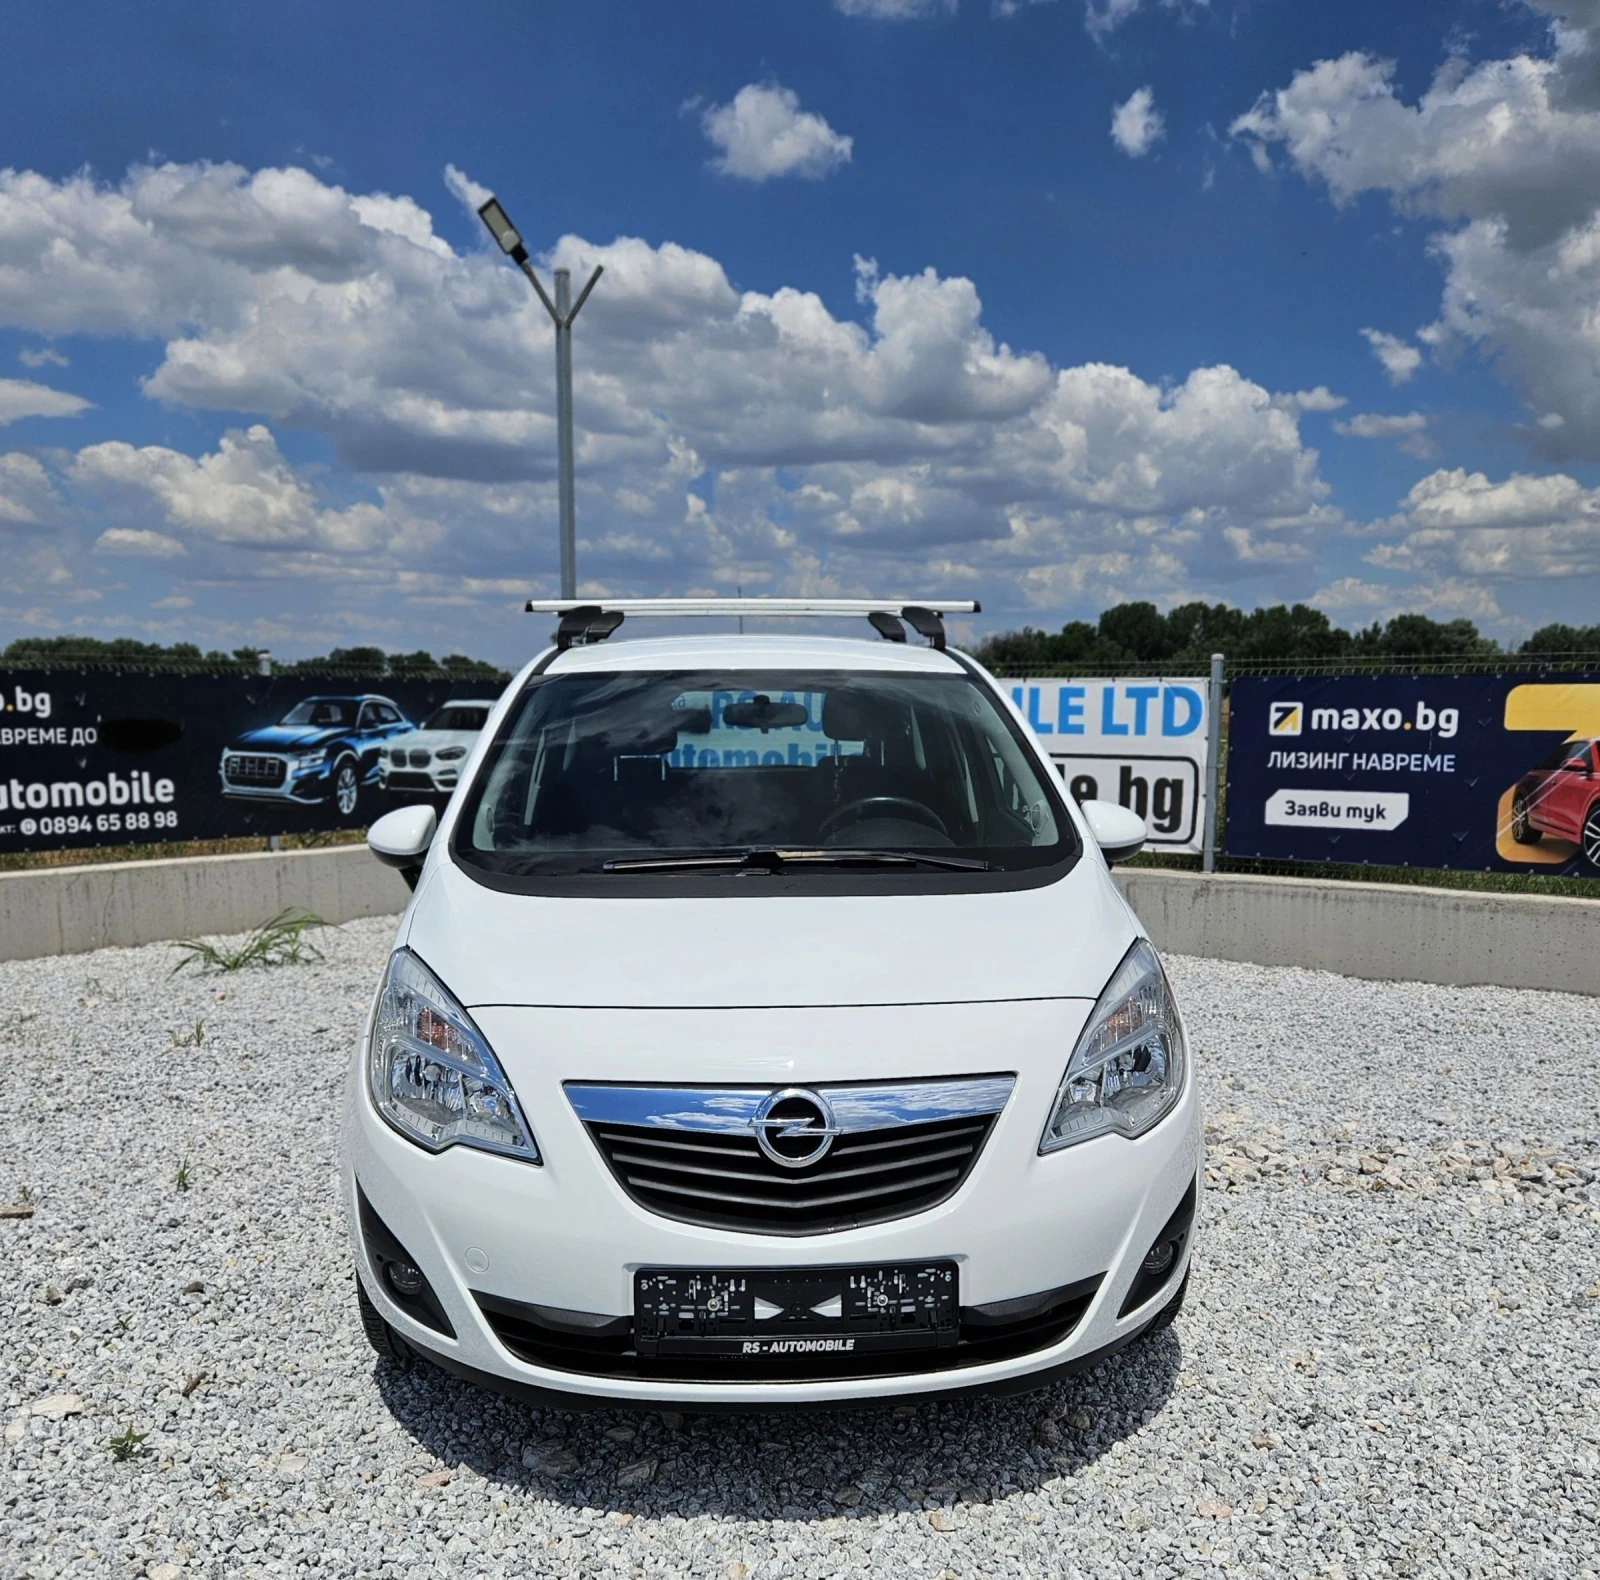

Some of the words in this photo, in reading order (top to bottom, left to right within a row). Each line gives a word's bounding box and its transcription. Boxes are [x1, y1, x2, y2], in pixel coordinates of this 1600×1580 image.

[0, 685, 52, 719] .bg
[1101, 685, 1203, 736] LTD
[1311, 701, 1459, 738] maxo.bg
[0, 727, 68, 745] ВРЕМЕ
[70, 727, 98, 747] ДО
[1267, 751, 1350, 770] ЛИЗИНГ
[1352, 753, 1456, 773] НАВРЕМЕ
[39, 815, 92, 835] 0894
[96, 813, 121, 831] 65
[125, 812, 150, 830] 88
[153, 810, 178, 828] 98
[1284, 800, 1341, 818] Заяви
[1346, 804, 1386, 823] тук
[742, 1342, 760, 1353] RS
[769, 1339, 855, 1353] AUTOMOBILE
